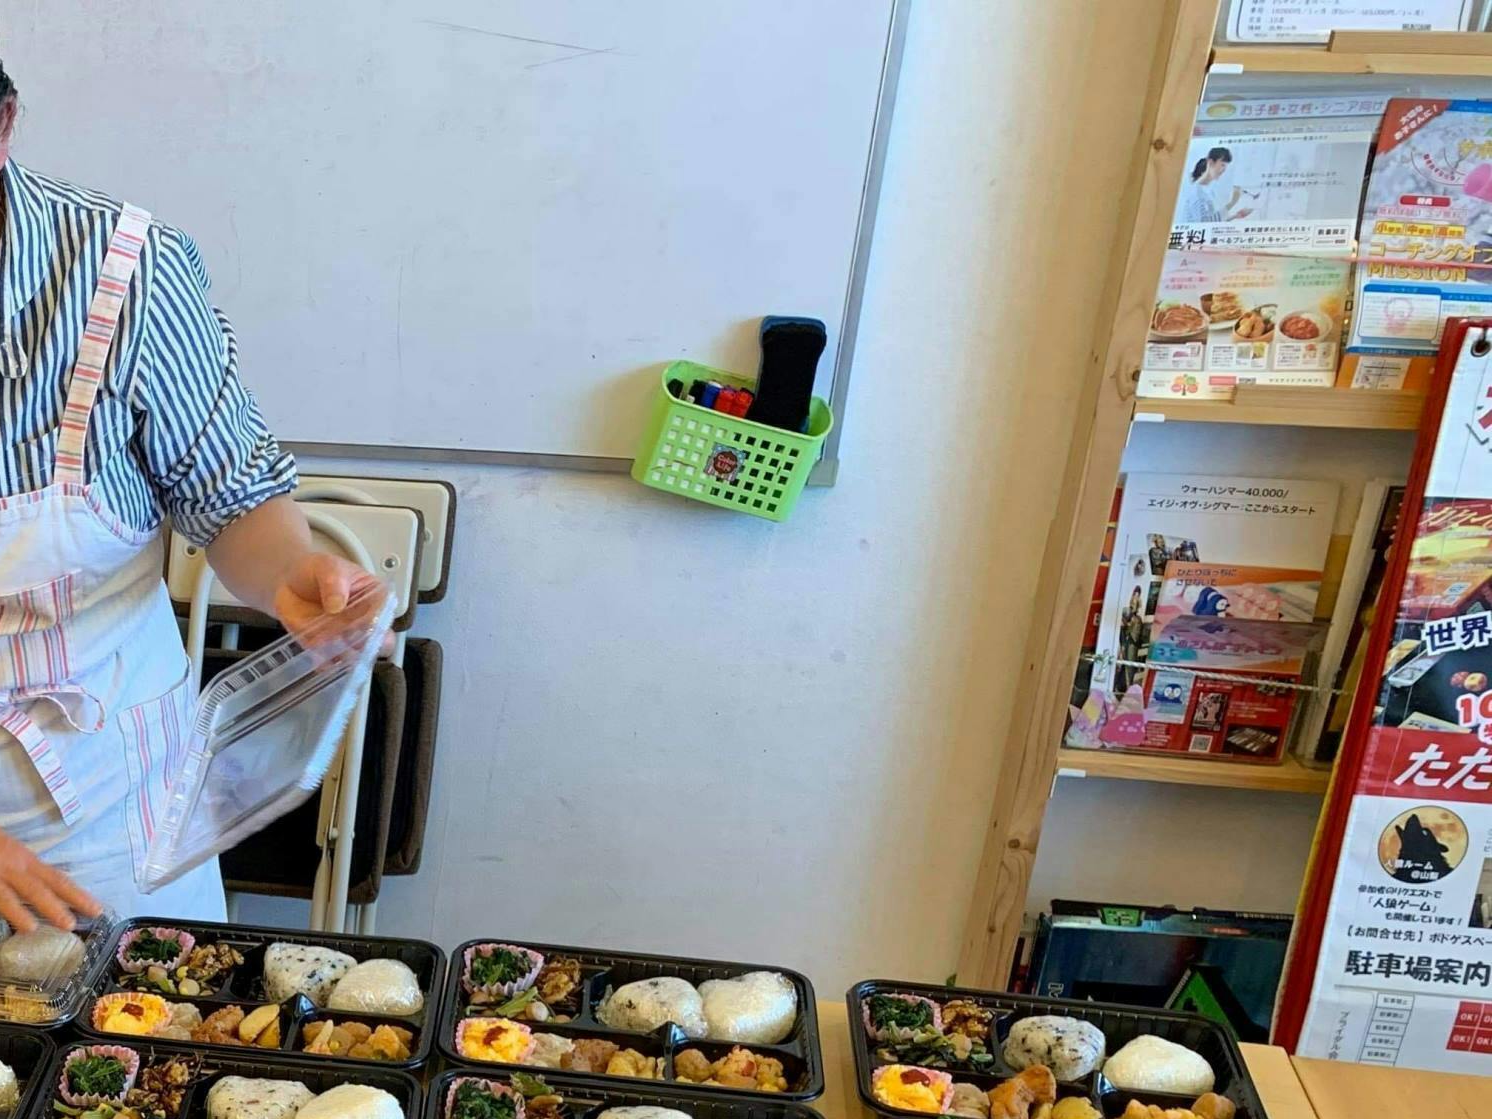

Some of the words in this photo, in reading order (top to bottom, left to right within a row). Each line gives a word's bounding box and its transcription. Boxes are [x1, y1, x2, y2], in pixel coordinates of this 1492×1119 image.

[1426, 614, 1492, 652] 世界
[1345, 949, 1492, 987] 駐車場案内
